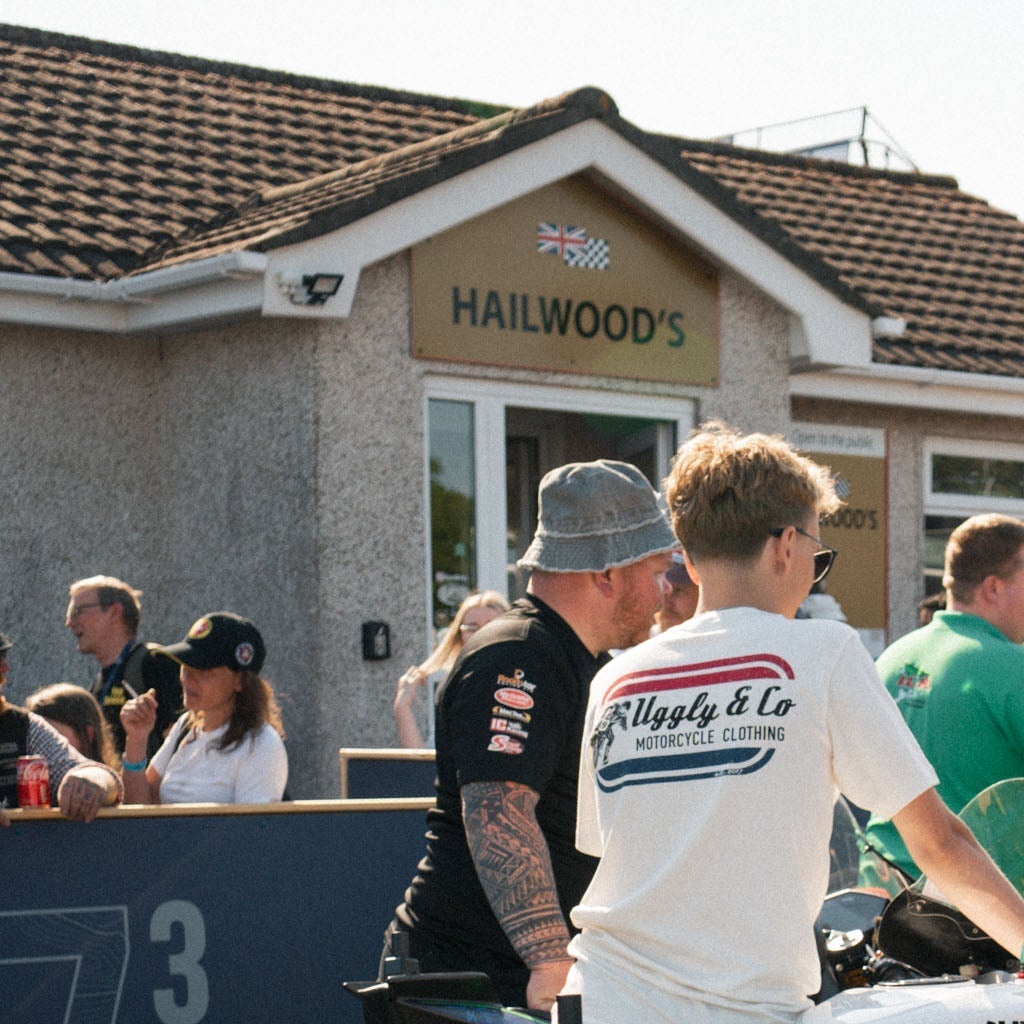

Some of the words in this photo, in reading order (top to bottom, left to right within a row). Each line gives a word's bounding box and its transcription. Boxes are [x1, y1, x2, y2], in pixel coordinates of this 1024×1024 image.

[452, 286, 685, 347] HAILWOOD'S
[632, 692, 720, 731] Uggly
[726, 686, 752, 716] &
[757, 686, 797, 717] Co
[636, 730, 715, 751] MOTORCYCLE
[723, 726, 785, 742] CLOTHING
